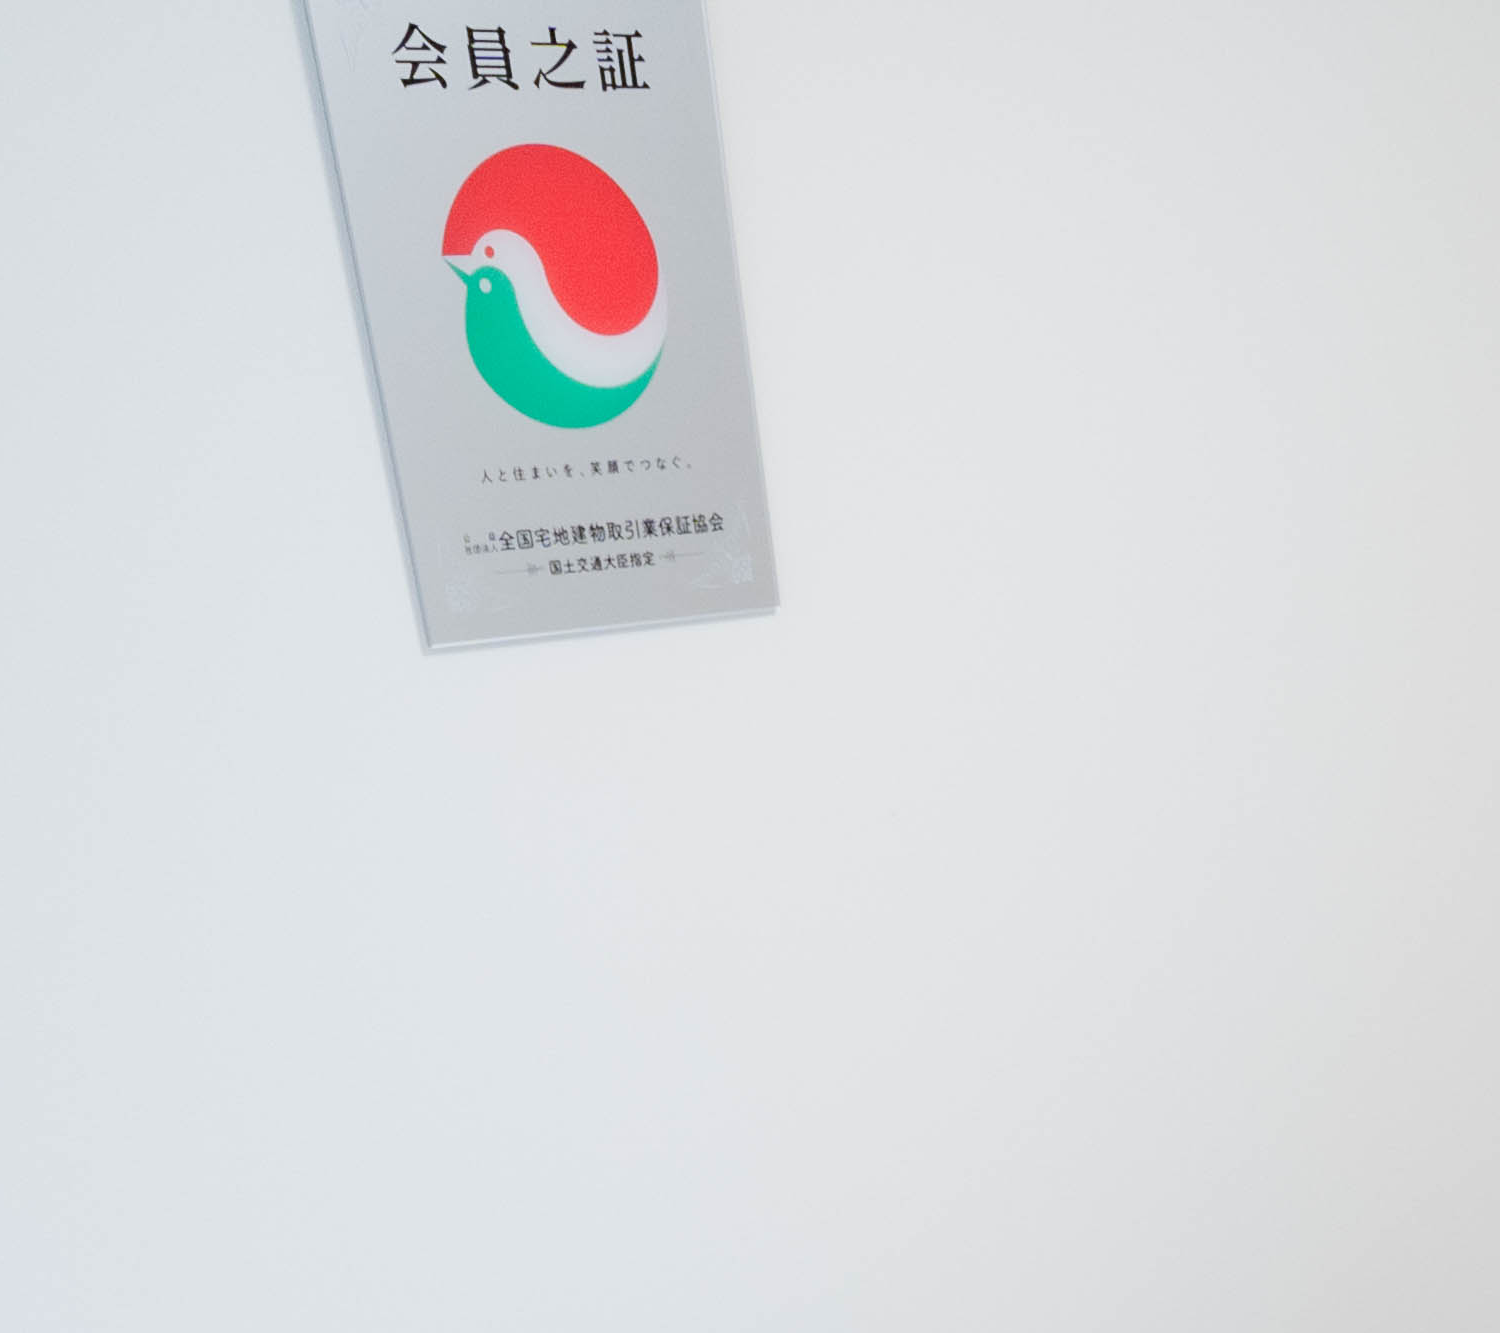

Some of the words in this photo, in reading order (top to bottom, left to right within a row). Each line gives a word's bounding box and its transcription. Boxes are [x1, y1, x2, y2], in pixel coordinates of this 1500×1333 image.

[391, 23, 652, 92] 会員之証
[481, 456, 692, 484] 人と住まいを、笑顔でつなぐ。
[499, 512, 724, 551] 全国宅地建物取引業保証協会
[549, 551, 656, 576] 国土交通大臣指定
